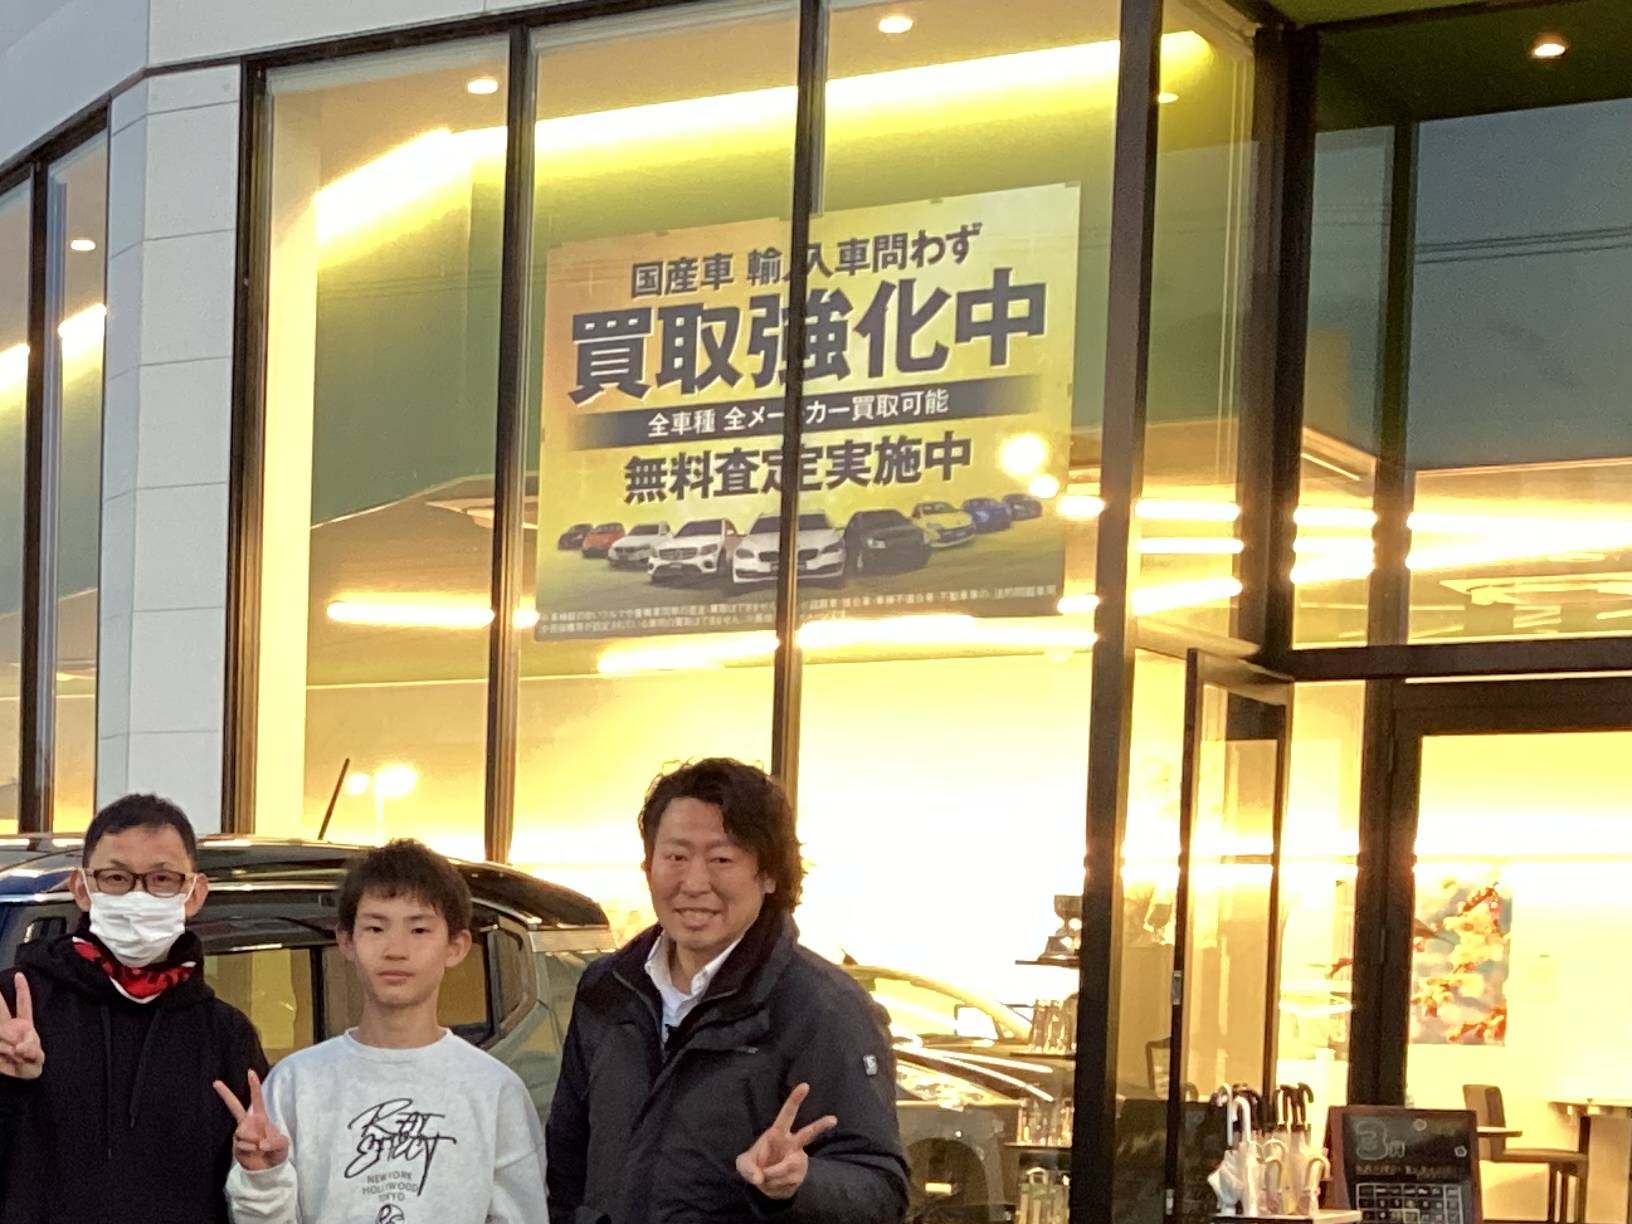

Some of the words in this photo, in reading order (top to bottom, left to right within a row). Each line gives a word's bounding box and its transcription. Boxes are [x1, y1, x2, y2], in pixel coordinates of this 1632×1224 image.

[631, 252, 735, 298] 国産車
[568, 266, 1047, 405] 買取強化中
[647, 410, 717, 438] 全車種
[624, 430, 972, 504] 無料査定実施中
